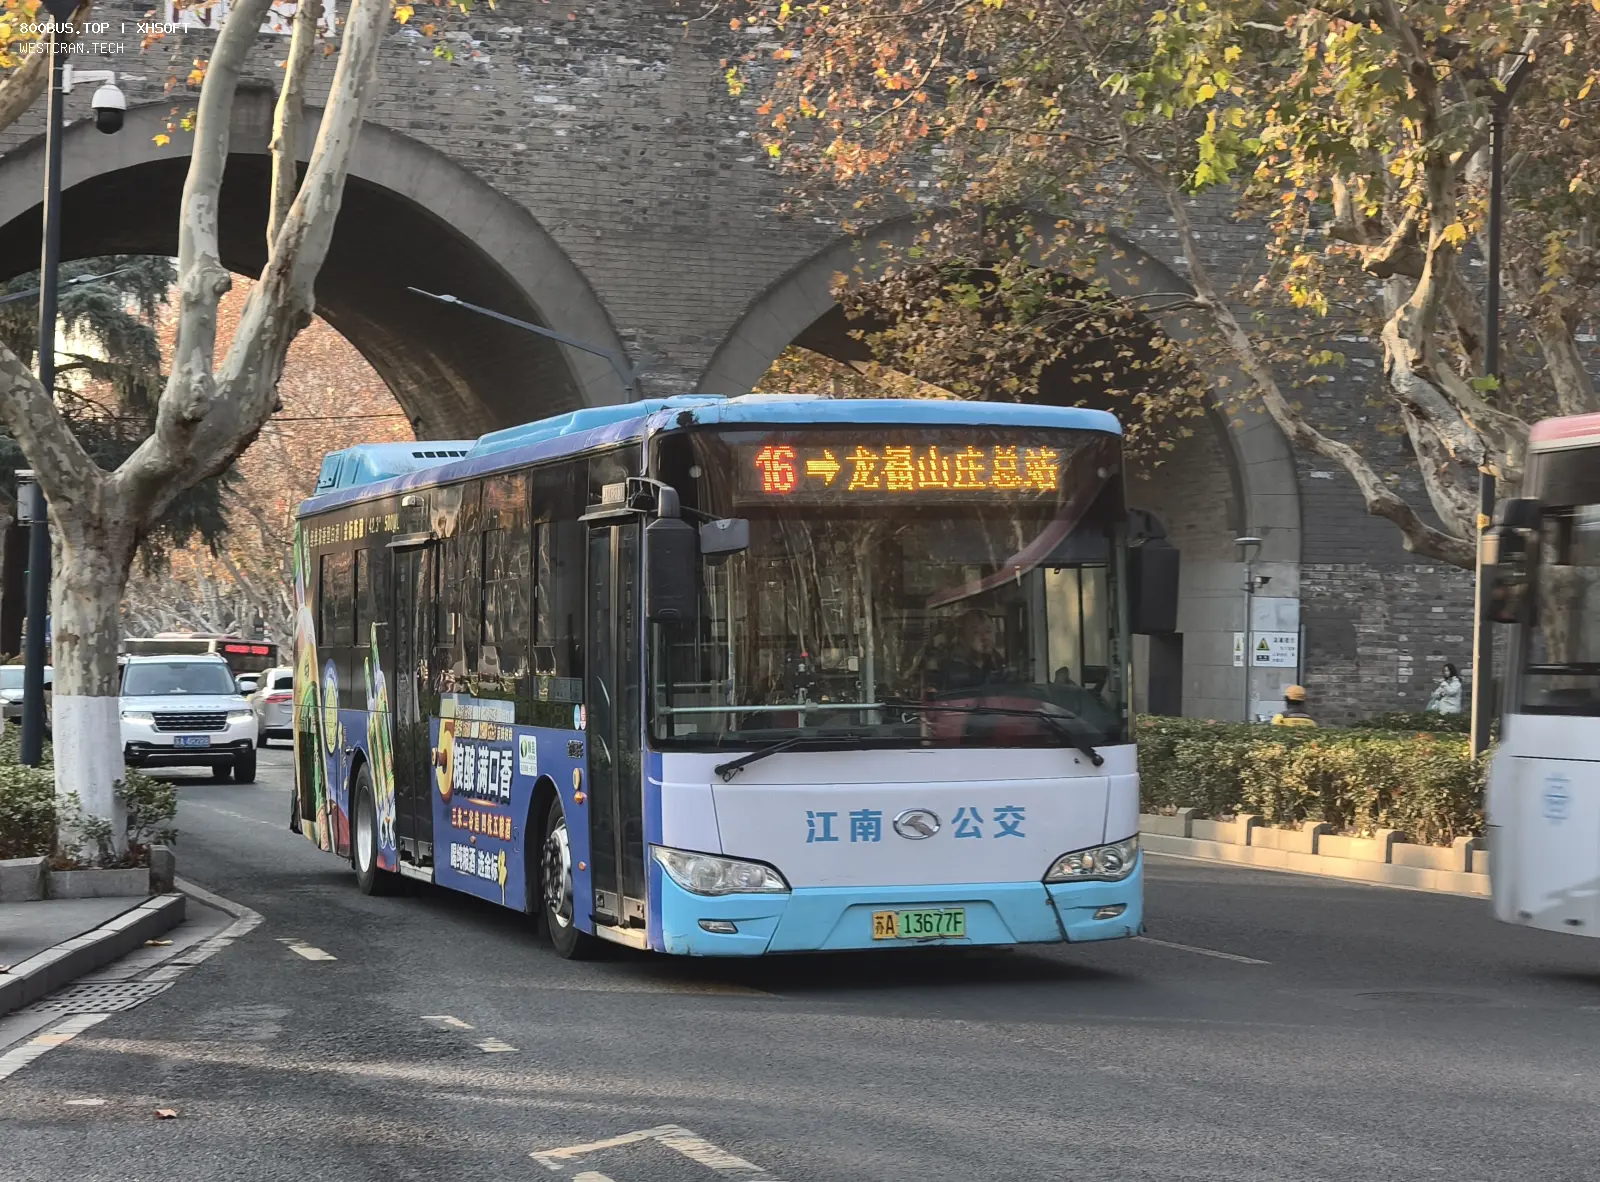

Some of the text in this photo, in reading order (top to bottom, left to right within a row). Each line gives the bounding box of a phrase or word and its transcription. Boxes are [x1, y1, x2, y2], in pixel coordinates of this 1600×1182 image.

[756, 445, 795, 491] 16
[806, 805, 1026, 843] 江南 公交
